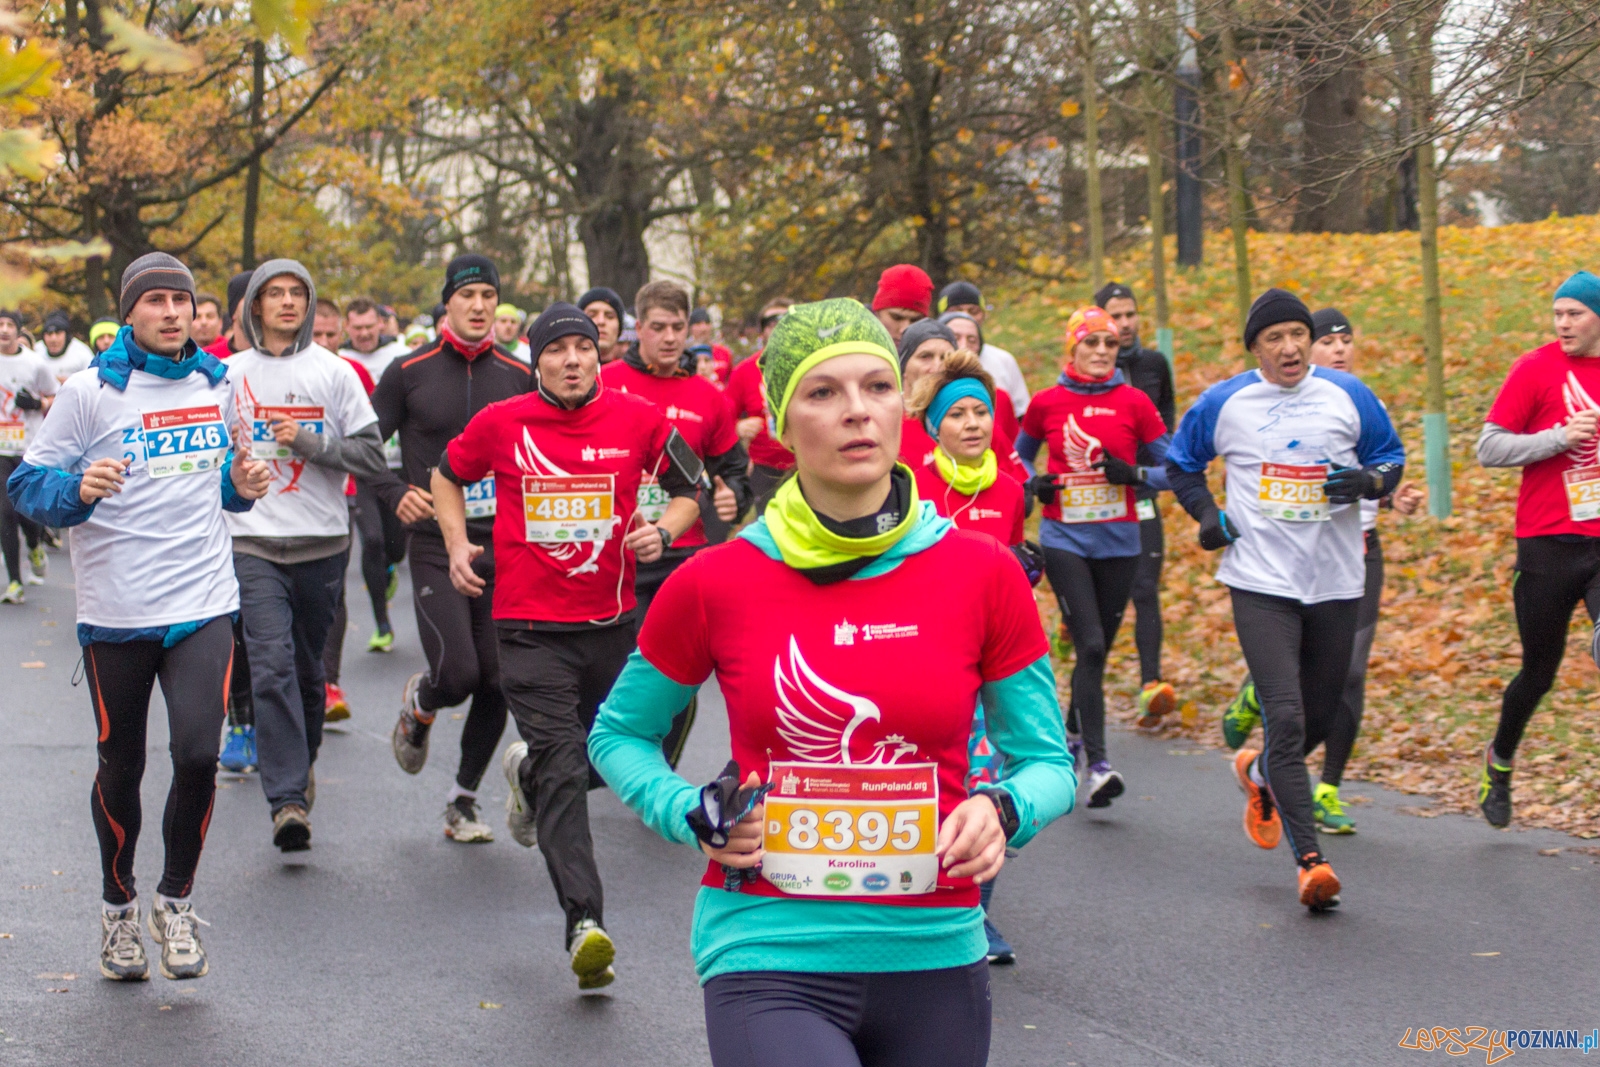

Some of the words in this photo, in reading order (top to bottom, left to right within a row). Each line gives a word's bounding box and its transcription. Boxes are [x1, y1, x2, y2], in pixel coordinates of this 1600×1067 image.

[157, 426, 221, 454] 2746
[1268, 482, 1322, 502] 8205
[536, 497, 601, 519] 4881
[861, 781, 928, 792] RunPoland.org
[768, 820, 781, 835] D
[787, 808, 921, 852] 8395
[828, 859, 876, 869] Karolina
[770, 872, 797, 881] GRUPA
